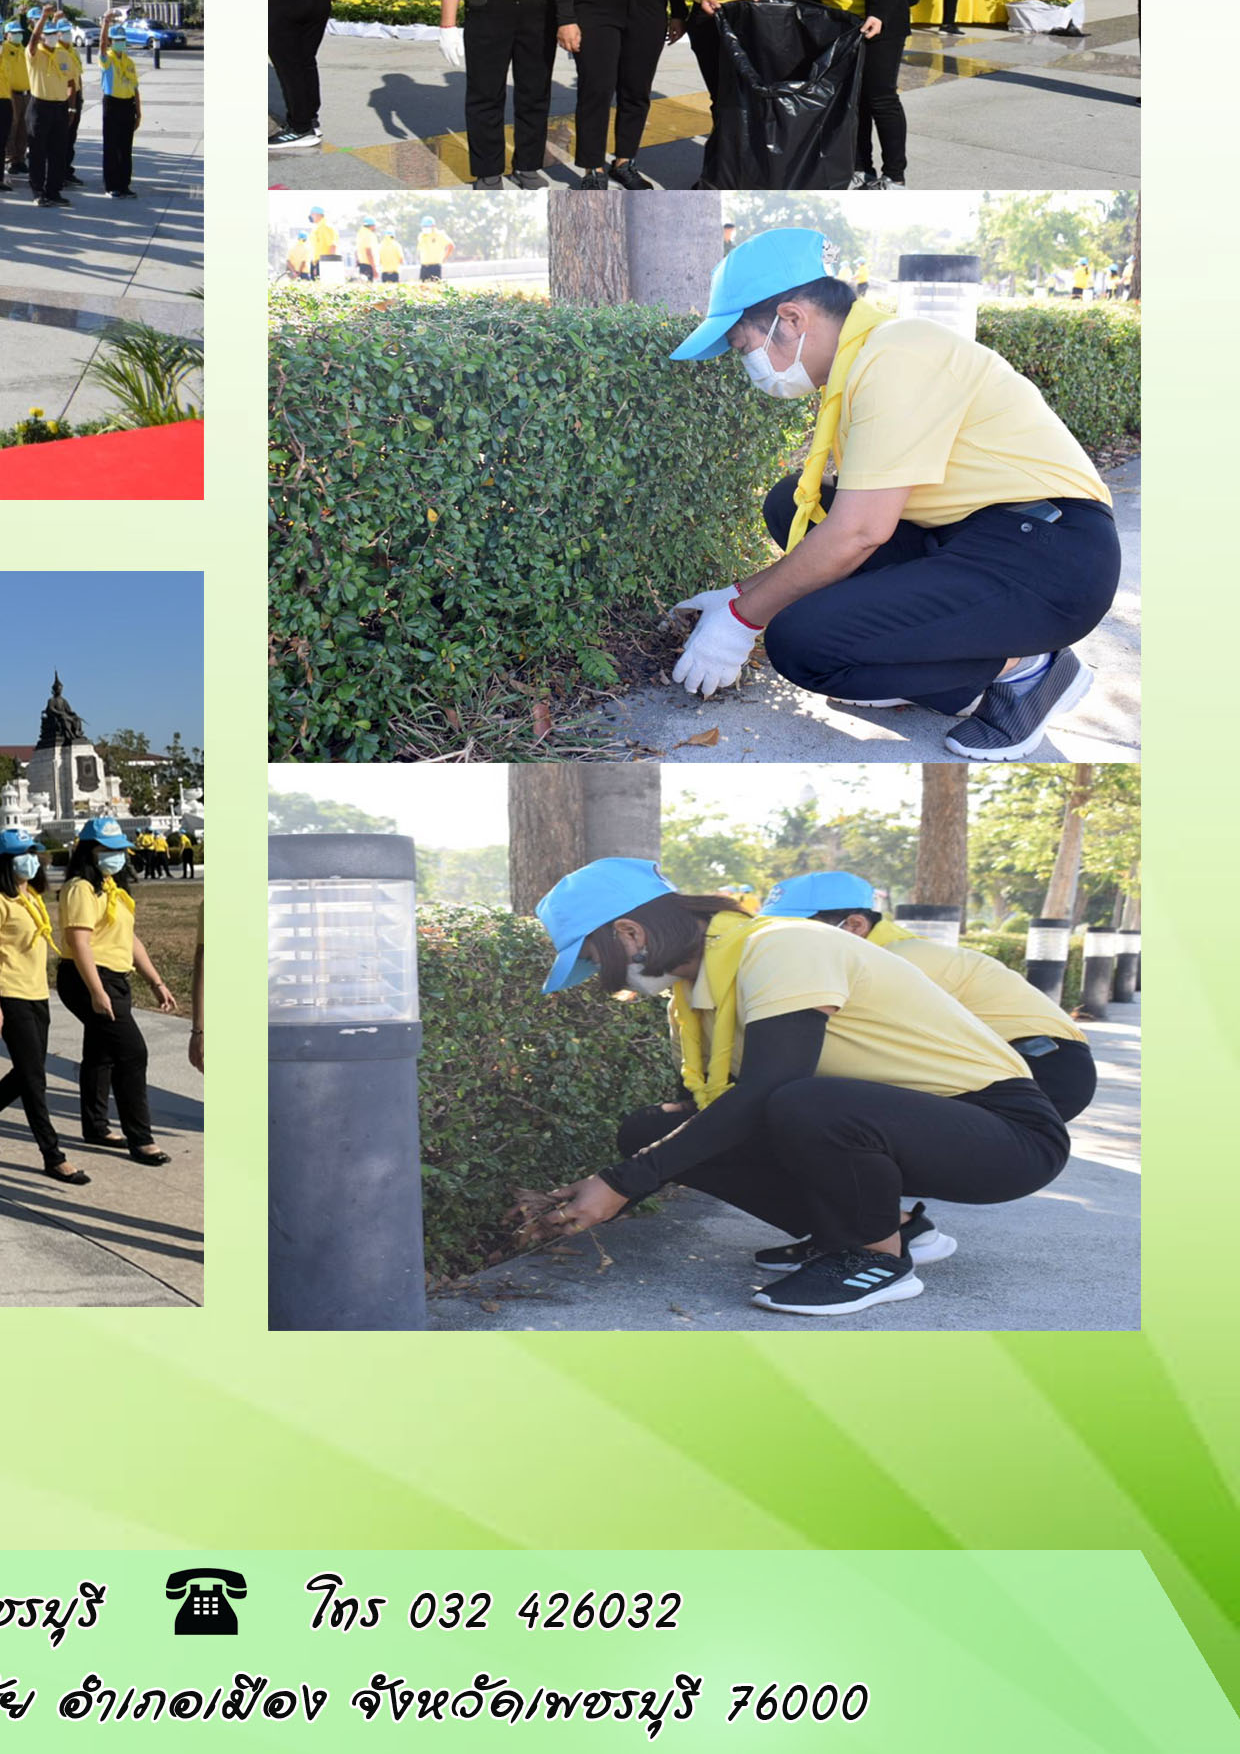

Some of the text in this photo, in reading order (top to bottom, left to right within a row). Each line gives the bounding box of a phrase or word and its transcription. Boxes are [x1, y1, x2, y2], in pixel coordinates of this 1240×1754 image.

[306, 1573, 387, 1632] โทร
[410, 1592, 491, 1629] 032
[518, 1591, 681, 1629] 426032
[59, 1673, 328, 1722] อำเภอเมือง
[351, 1673, 702, 1739] จังหวัดเพชรบุรี
[727, 1683, 868, 1722] 76000
